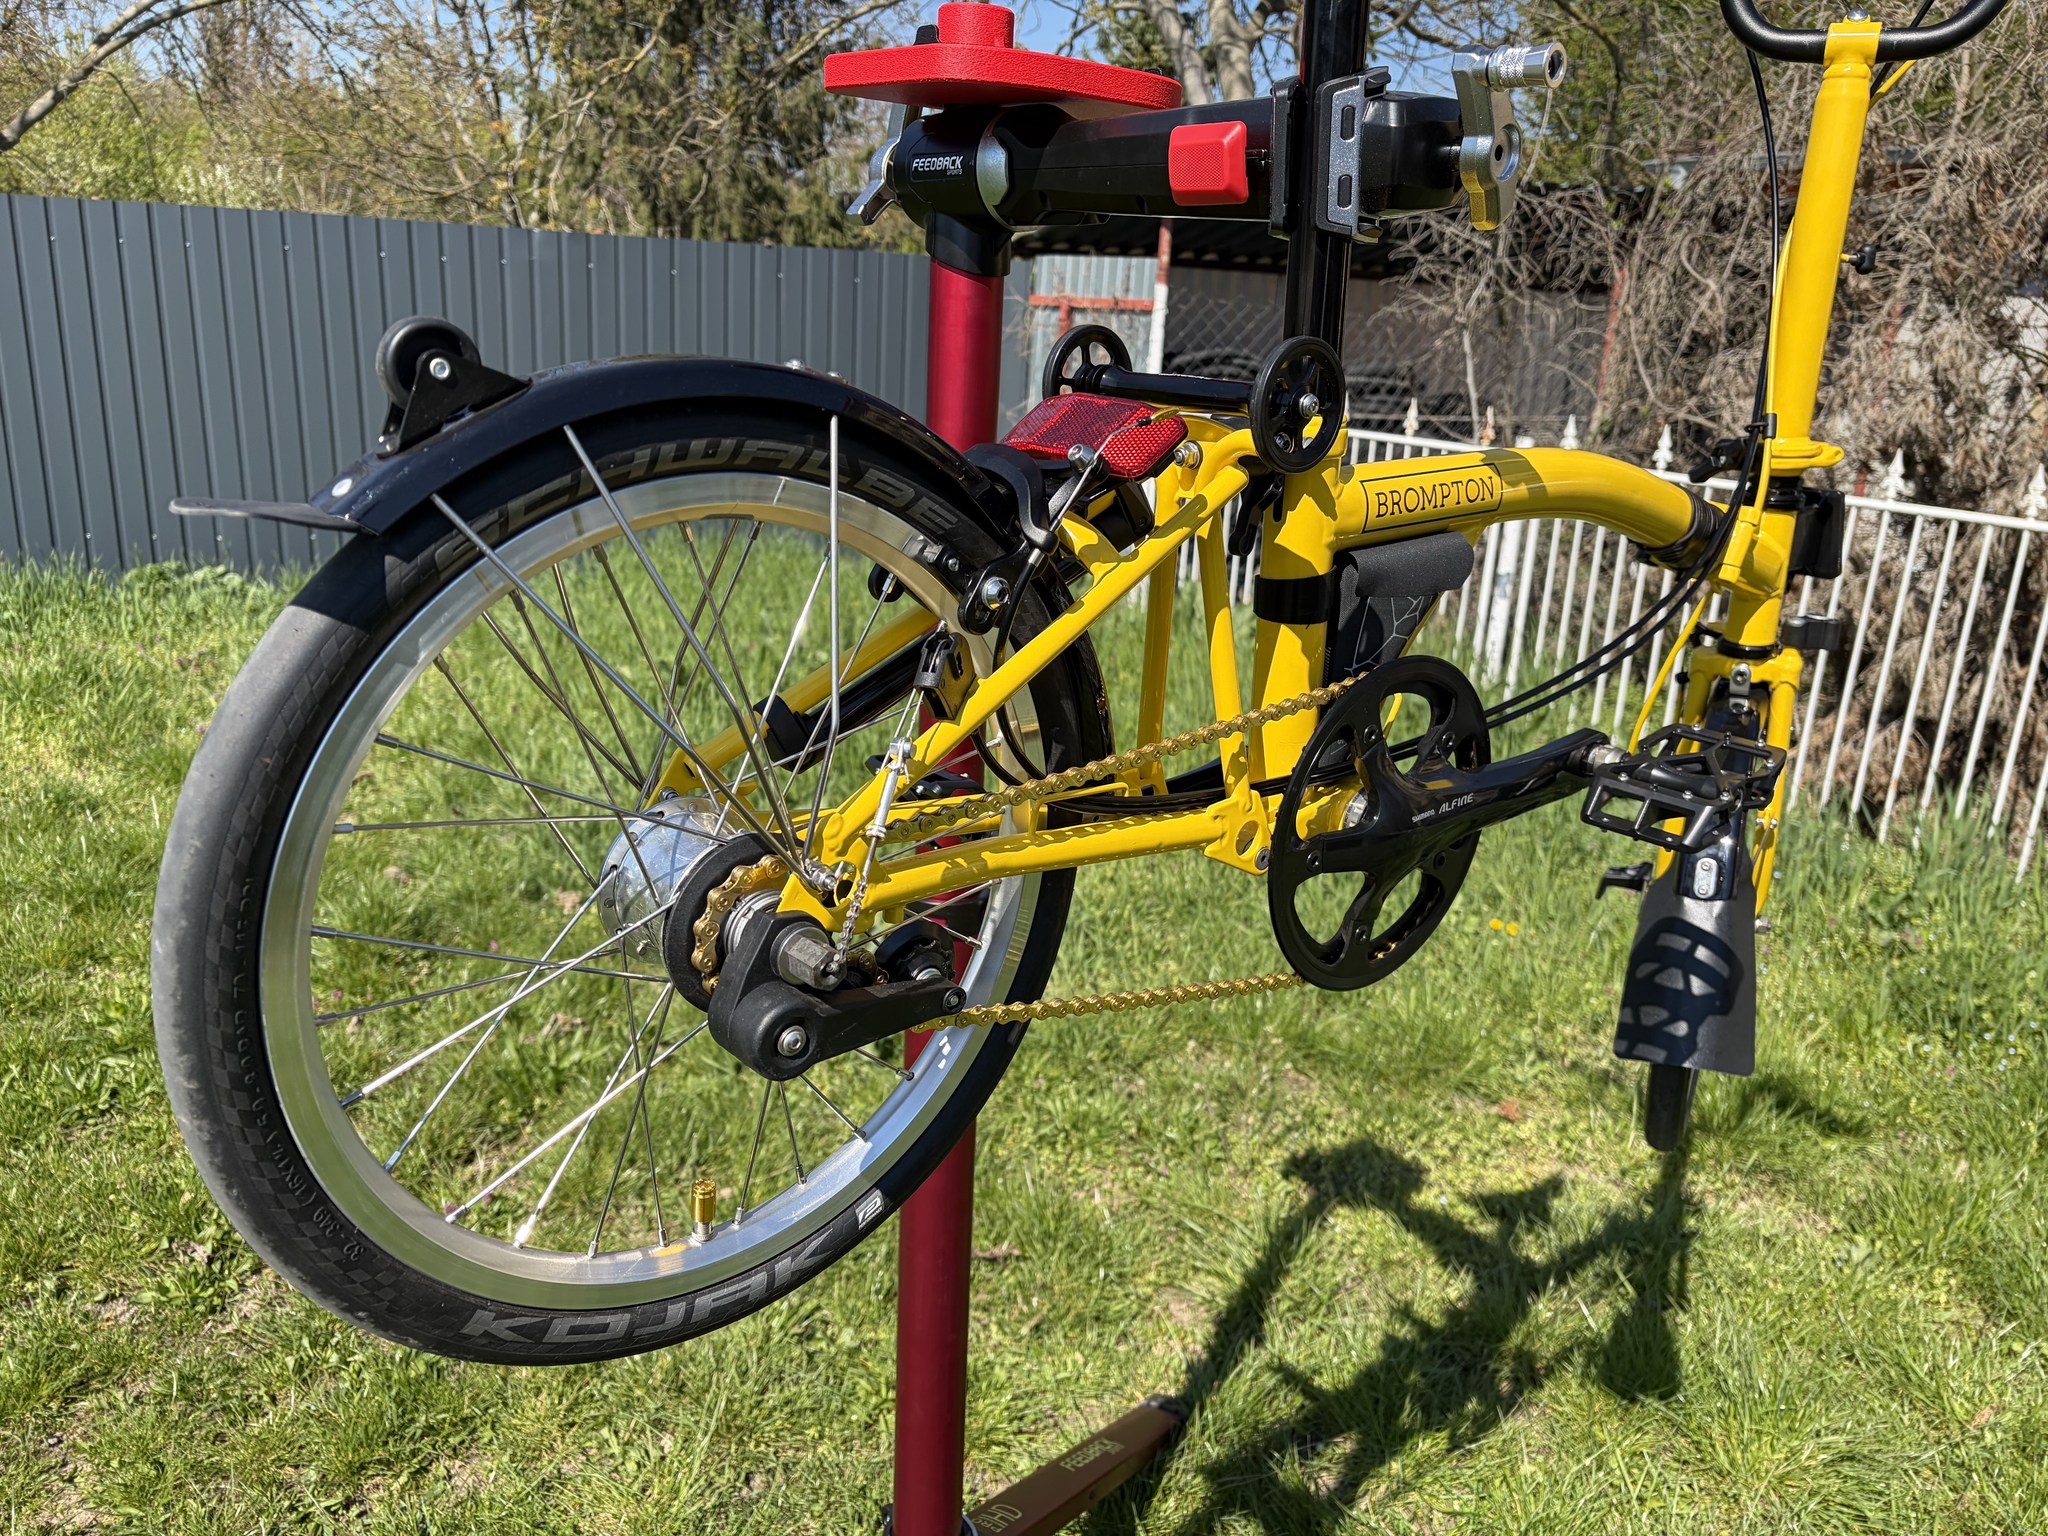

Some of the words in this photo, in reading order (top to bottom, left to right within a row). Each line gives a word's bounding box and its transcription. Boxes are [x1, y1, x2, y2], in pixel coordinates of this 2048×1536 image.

[912, 155, 964, 172] FEEDBACK
[434, 438, 961, 582] SCHWALBE
[1375, 476, 1494, 518] BROMPTON
[1438, 792, 1474, 814] ALFINE
[458, 1227, 834, 1344] KOJAK
